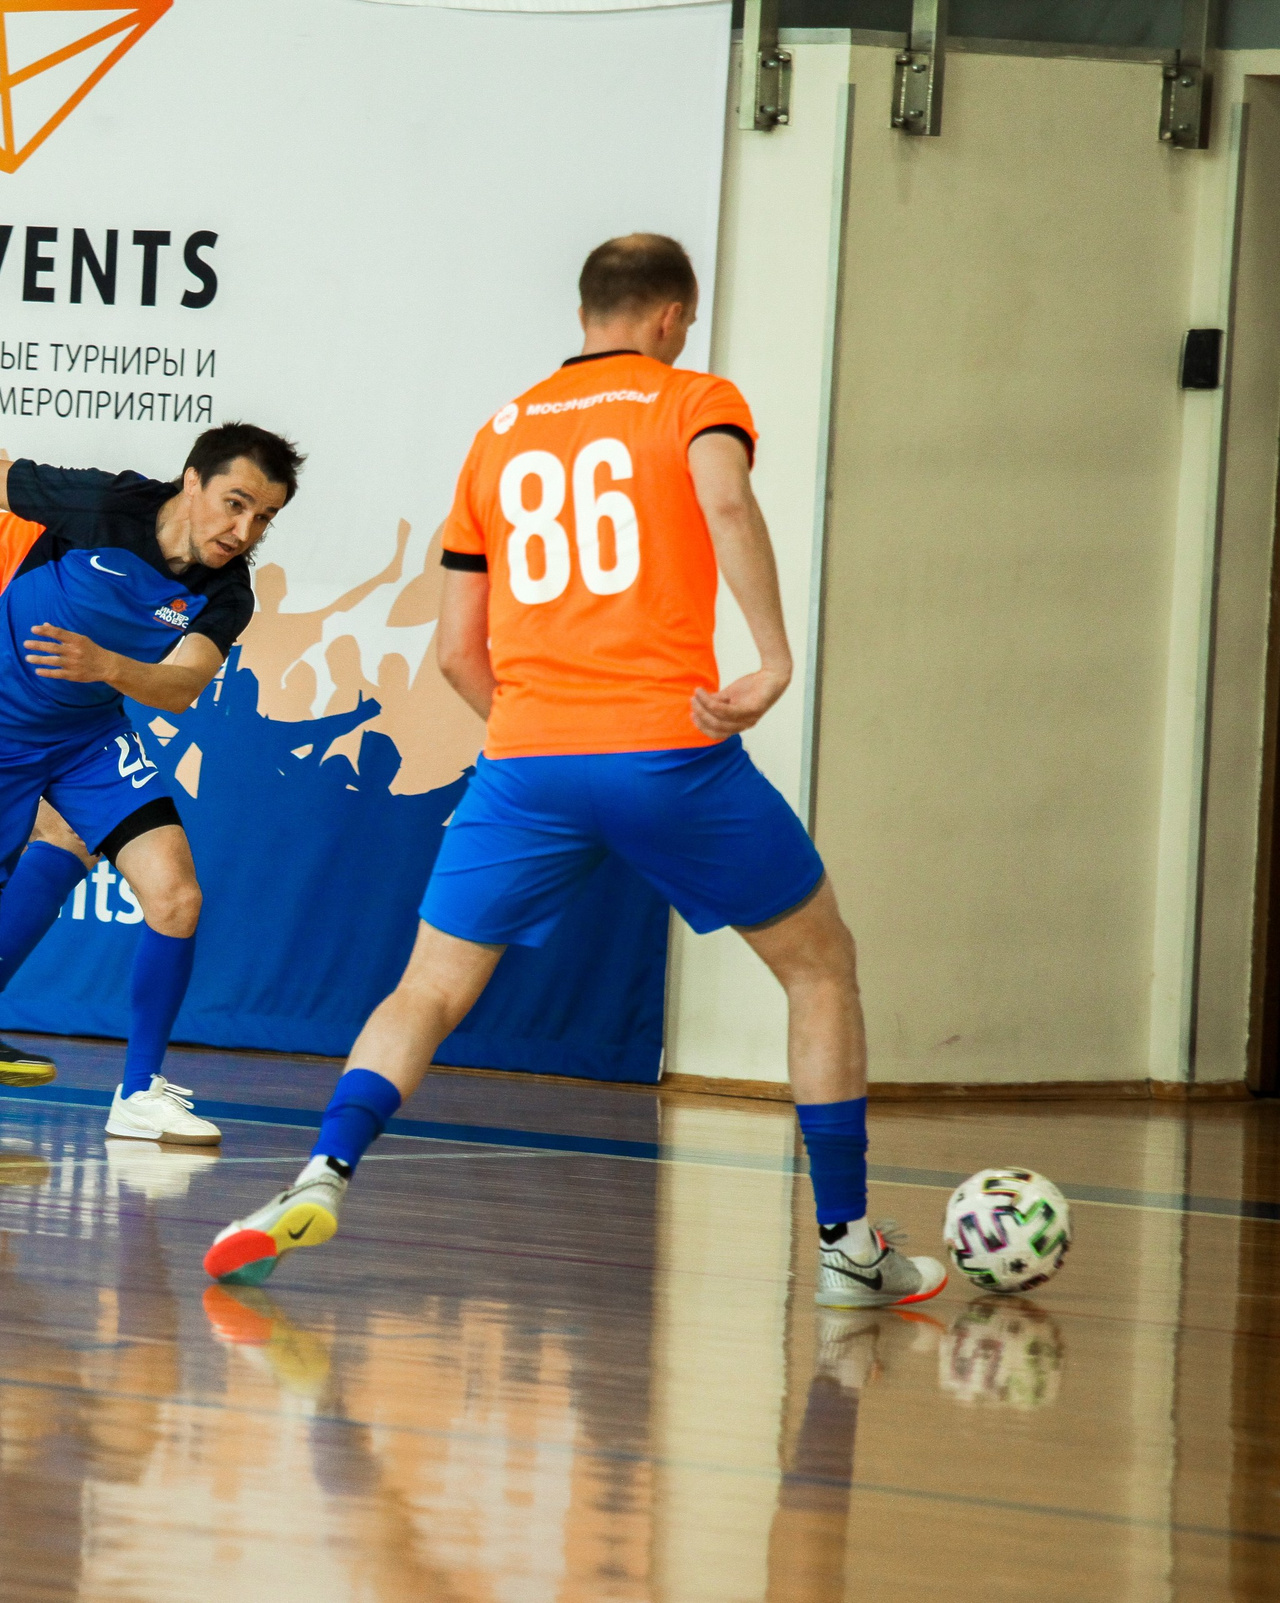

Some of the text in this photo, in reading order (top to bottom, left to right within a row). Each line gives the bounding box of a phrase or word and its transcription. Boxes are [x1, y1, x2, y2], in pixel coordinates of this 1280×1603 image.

[50, 343, 185, 377] ТУРНИРЫ
[196, 348, 216, 378] И
[499, 437, 640, 605] 86
